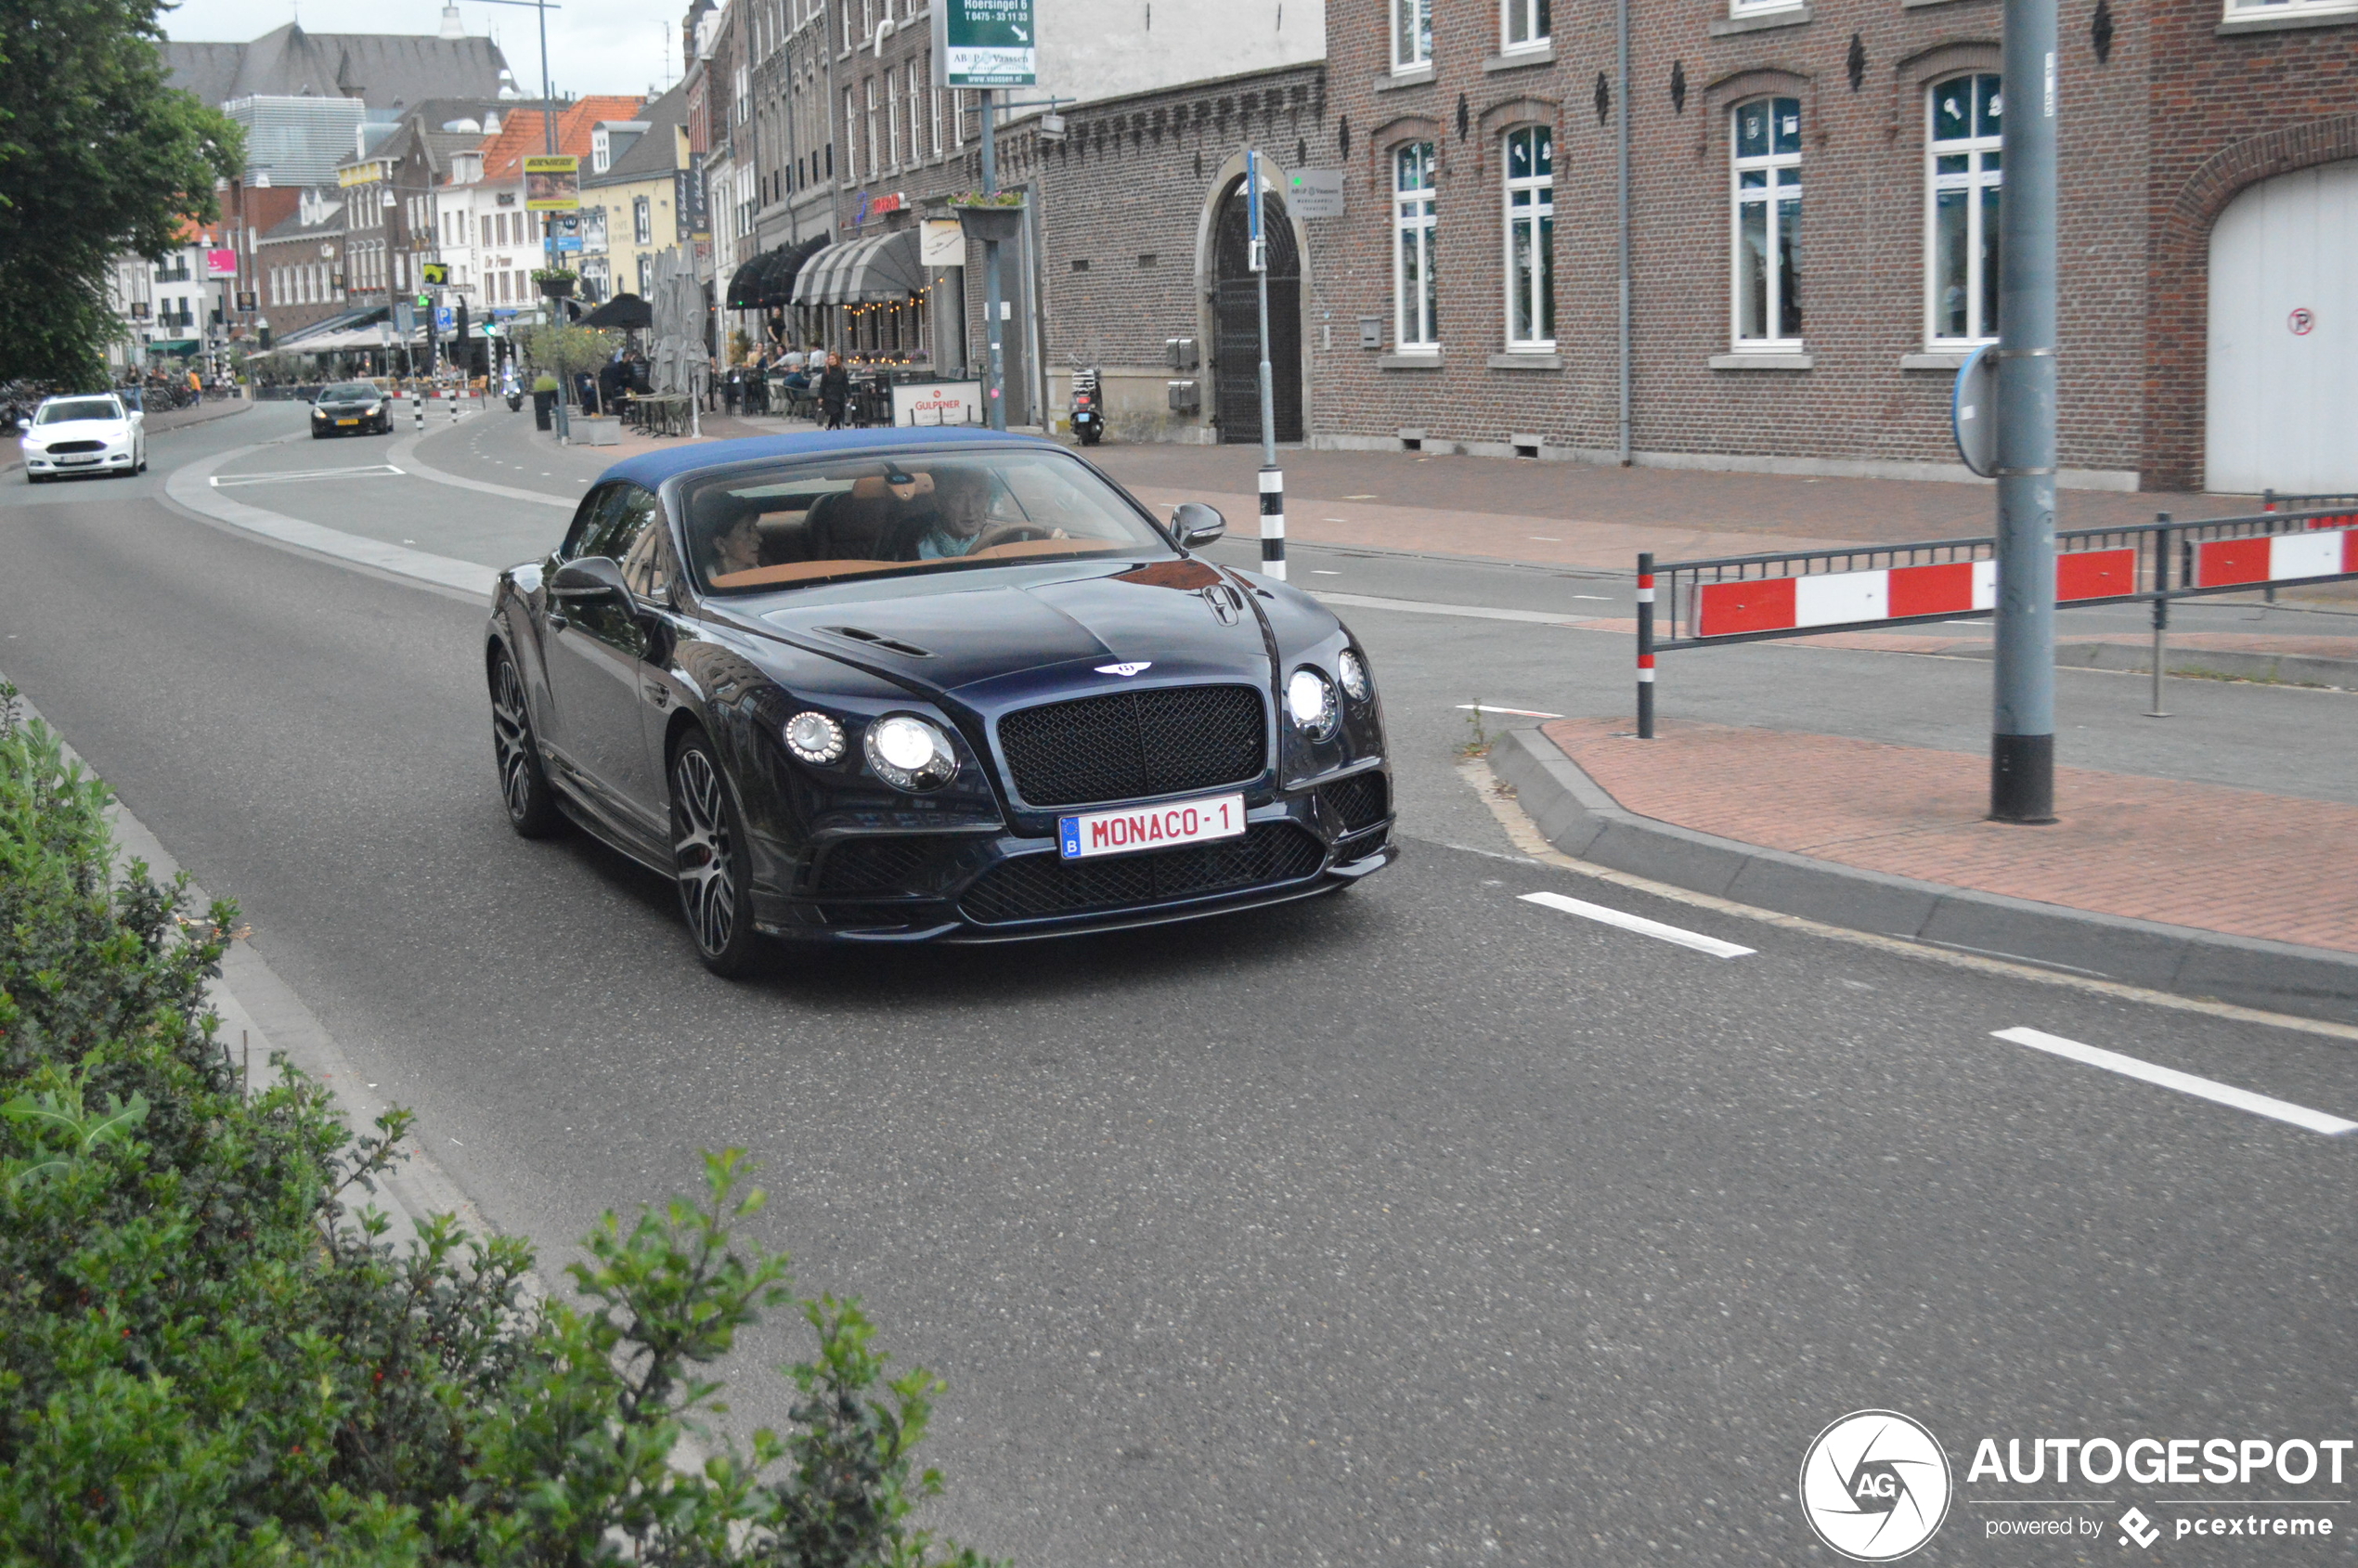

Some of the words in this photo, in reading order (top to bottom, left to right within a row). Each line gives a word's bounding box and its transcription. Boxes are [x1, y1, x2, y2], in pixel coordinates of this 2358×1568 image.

[965, 11, 970, 20] T
[971, 11, 991, 21] 0475
[996, 11, 1005, 21] 33
[1007, 12, 1017, 21] 11
[1017, 12, 1028, 21] 33
[992, 54, 1029, 62] Vaassen
[967, 75, 1023, 84] www.vaassen.nl
[468, 207, 477, 275] HOTEL
[915, 400, 960, 410] GULPENER
[1092, 803, 1230, 849] MONACO-1
[1067, 839, 1078, 853] B
